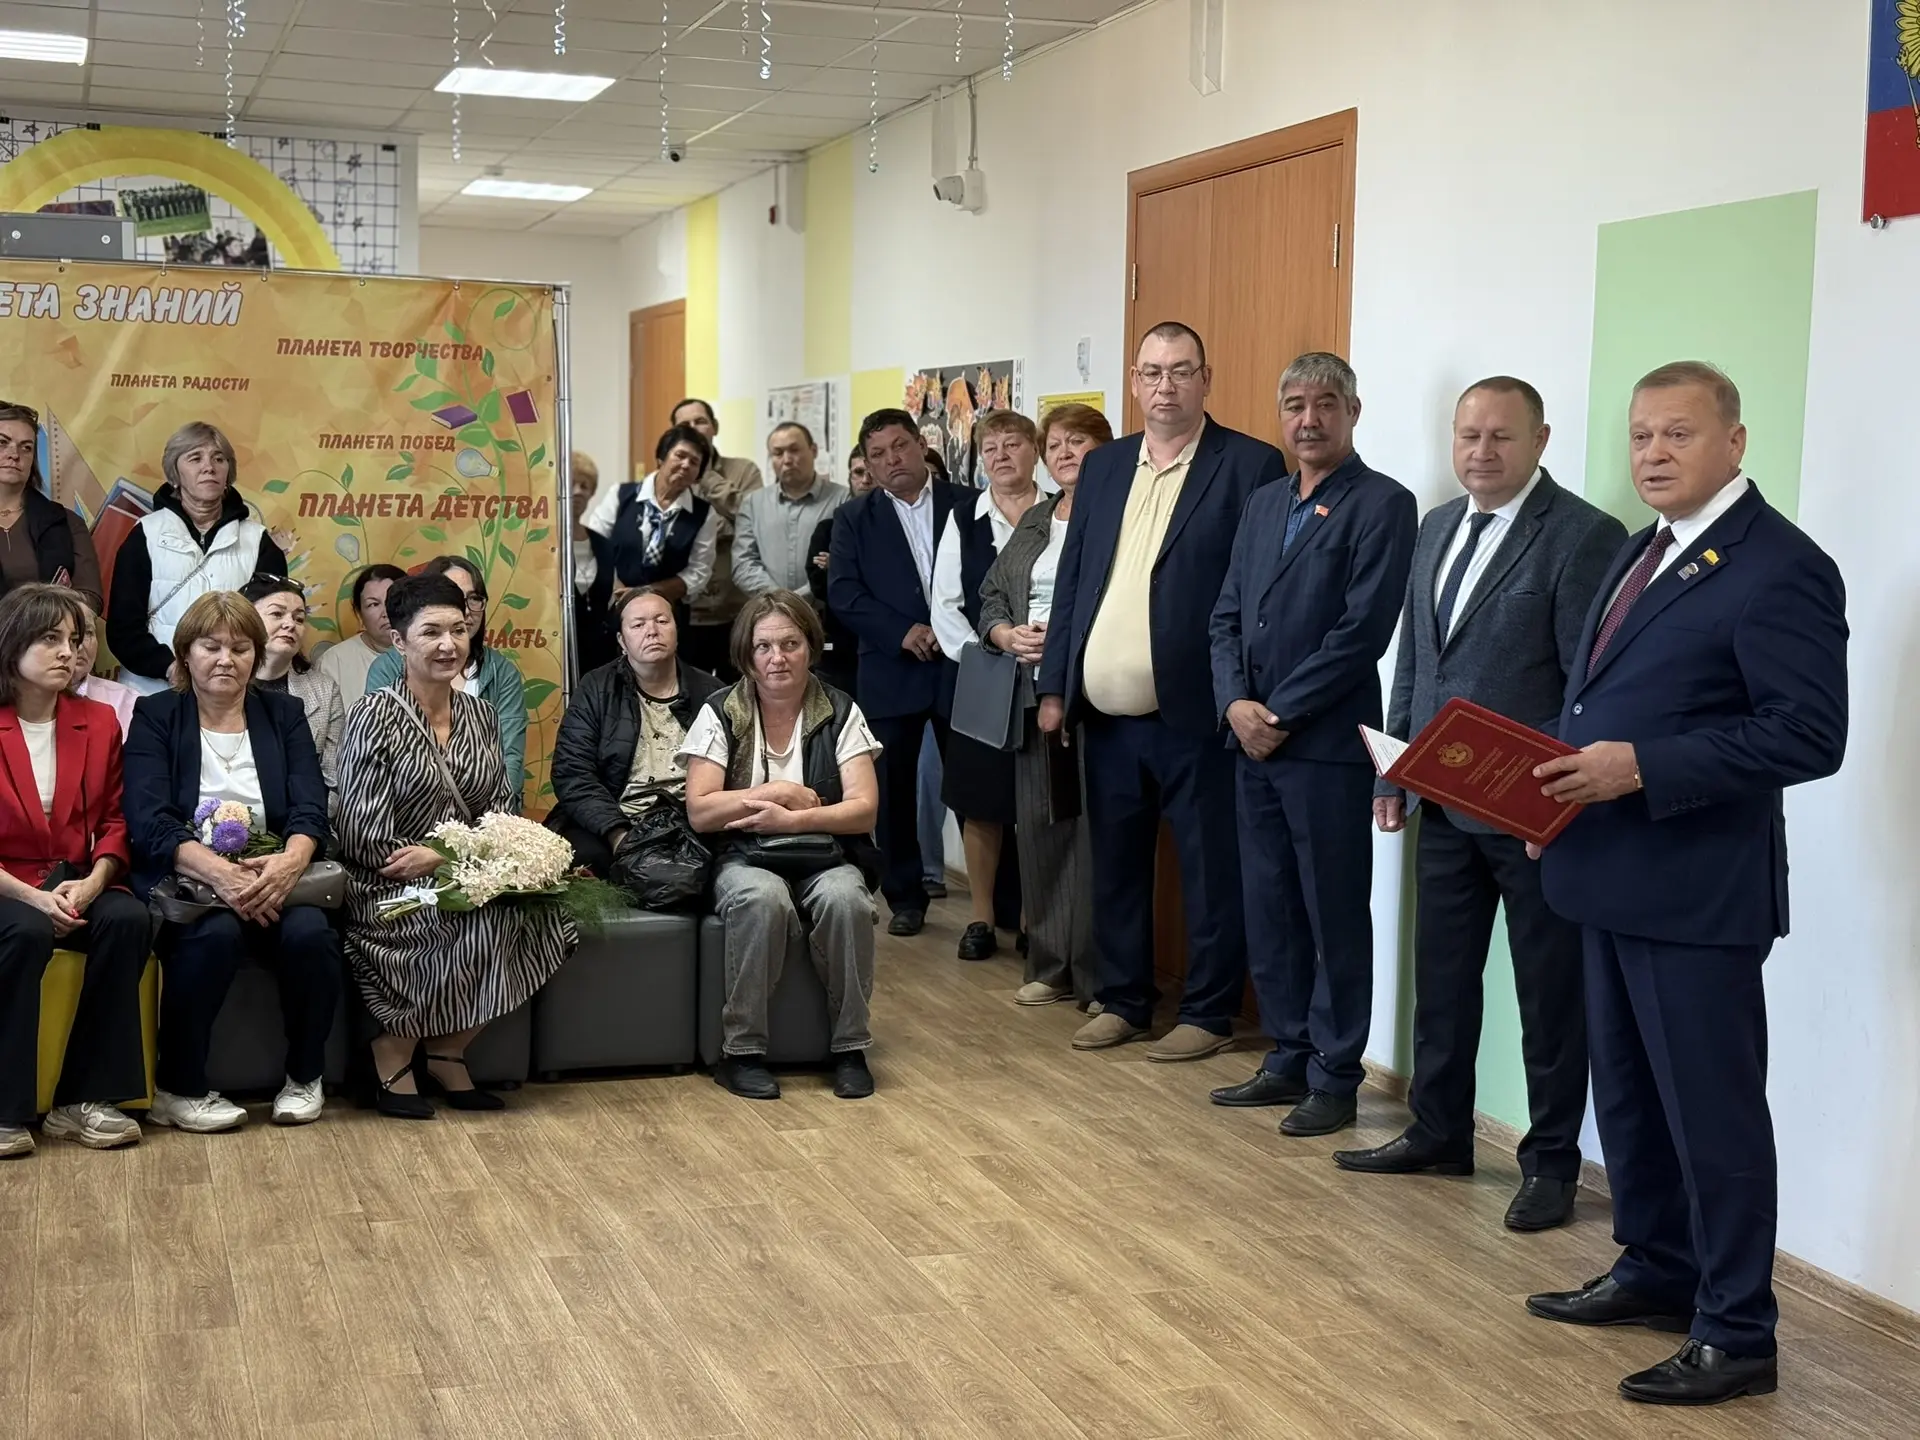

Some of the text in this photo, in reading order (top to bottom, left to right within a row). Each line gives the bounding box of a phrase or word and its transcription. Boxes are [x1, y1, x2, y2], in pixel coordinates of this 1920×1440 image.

[73, 282, 243, 326] ЗНАНИЙ
[277, 338, 483, 361] ПЛАНЕТА ТВОРЧЕСТВА
[110, 373, 250, 391] ПЛАНЕТА РАДОСТИ
[318, 433, 456, 452] ПЛАНЕТА ПОБЕД
[298, 493, 549, 521] ПЛАНЕТА ДЕТСТВА
